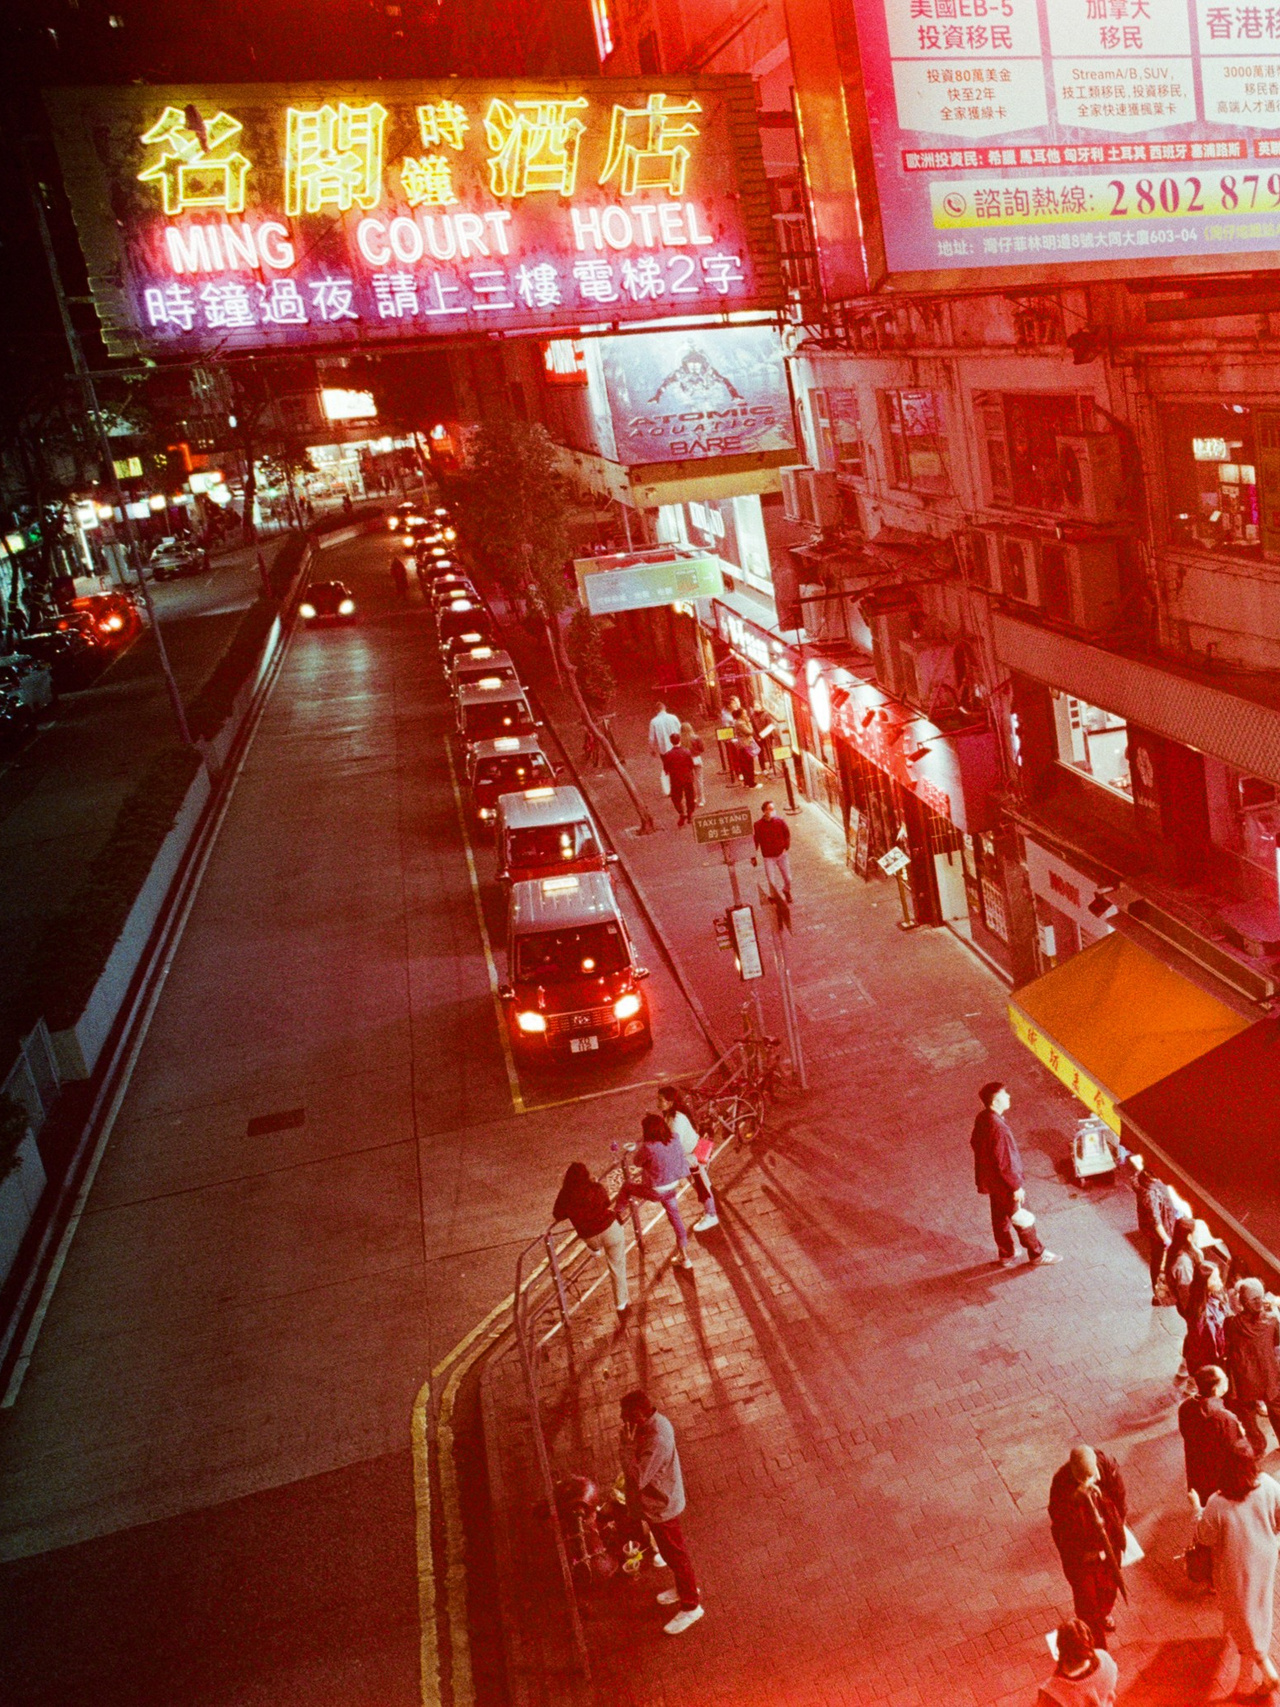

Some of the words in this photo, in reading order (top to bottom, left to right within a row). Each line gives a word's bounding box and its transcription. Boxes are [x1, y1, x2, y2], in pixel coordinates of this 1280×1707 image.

[917, 24, 1013, 50] 投資移民
[1100, 25, 1143, 50] 移民
[926, 68, 1012, 84] 投資80萬美金
[973, 185, 1096, 219] 諮詢熱線:
[1107, 177, 1204, 216] 2802
[164, 220, 295, 274] MING
[356, 210, 512, 266] COURT
[570, 202, 713, 251] HOTEL
[143, 276, 359, 331] 時鐘過夜
[371, 262, 562, 319] 請上三樓
[572, 252, 745, 303] 電梯2字
[629, 416, 776, 438] AQUATICS
[670, 435, 741, 456] BARE
[697, 817, 717, 828] TAXI
[719, 812, 748, 825] STAND
